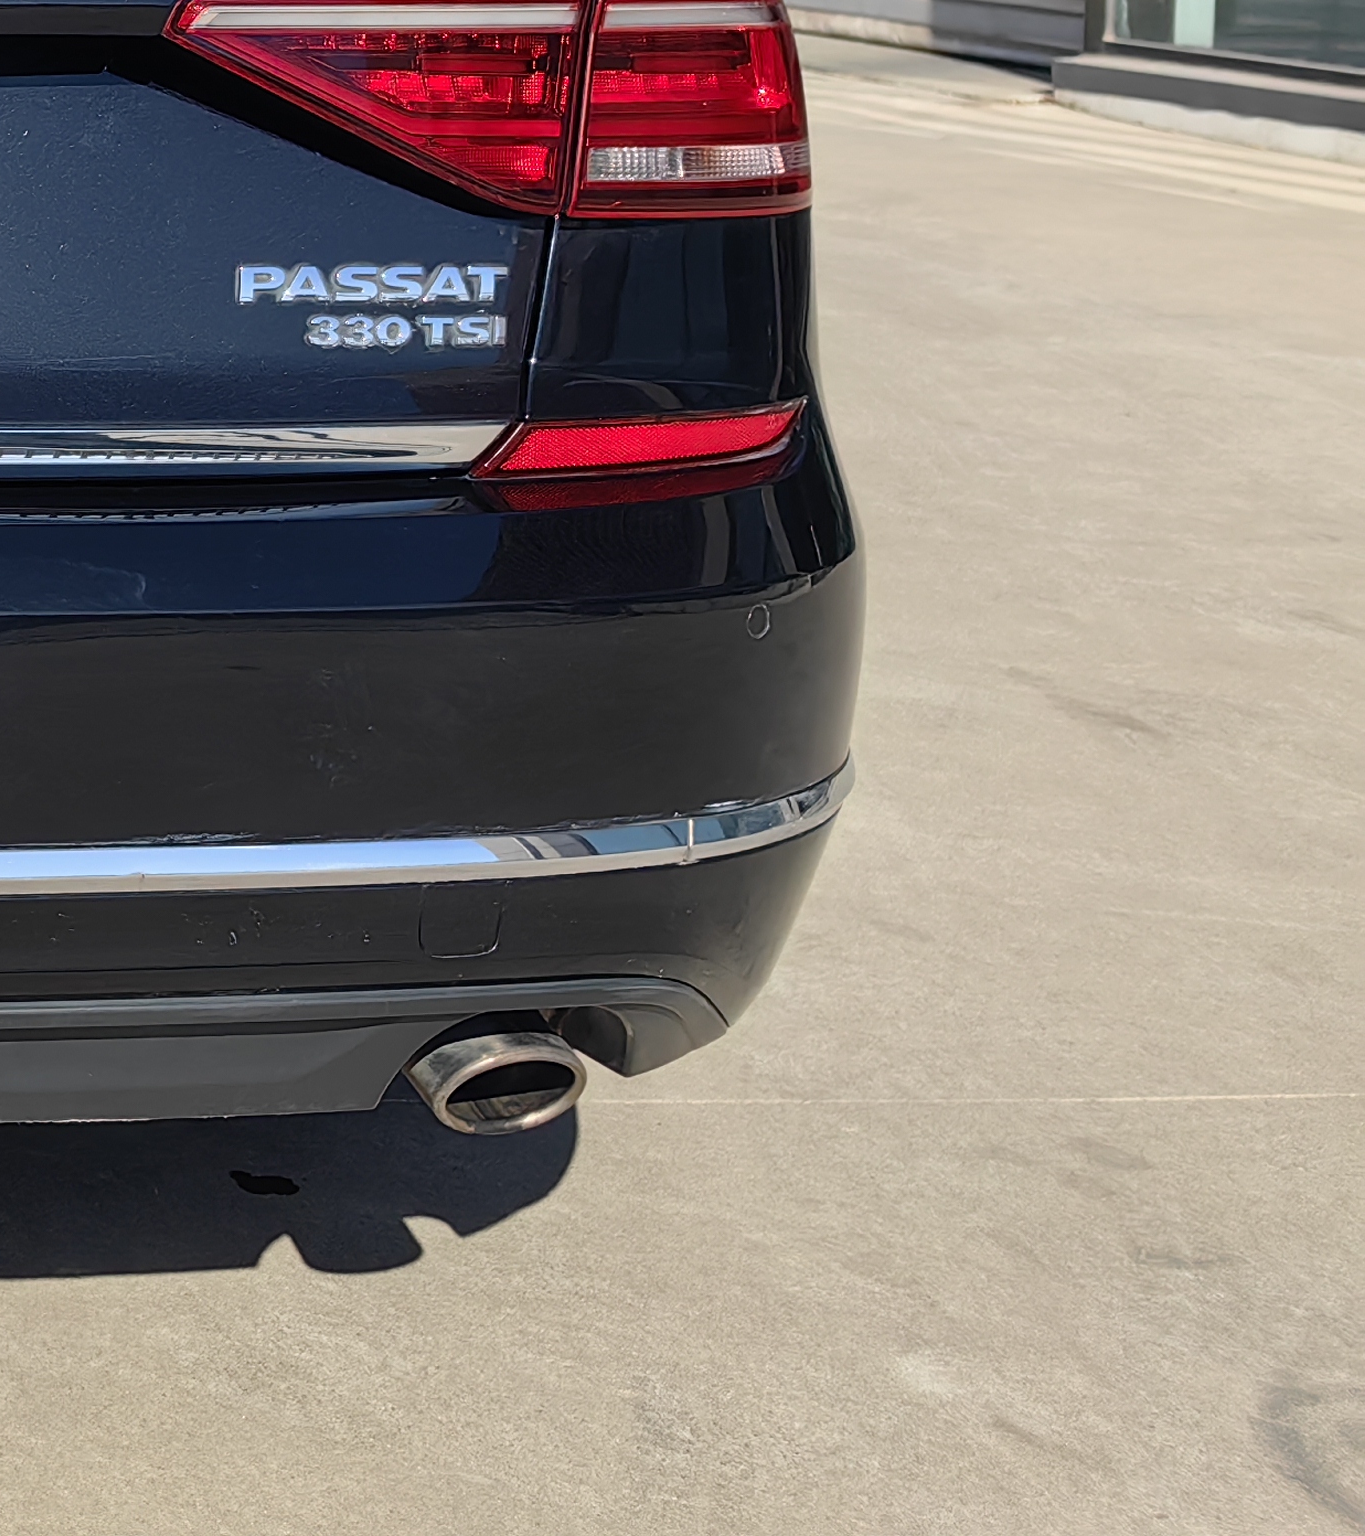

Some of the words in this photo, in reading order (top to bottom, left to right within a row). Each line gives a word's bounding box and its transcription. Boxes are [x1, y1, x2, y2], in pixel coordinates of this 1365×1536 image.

[236, 265, 510, 304] PASSAT
[305, 315, 413, 349] 330
[419, 315, 507, 347] TSI
